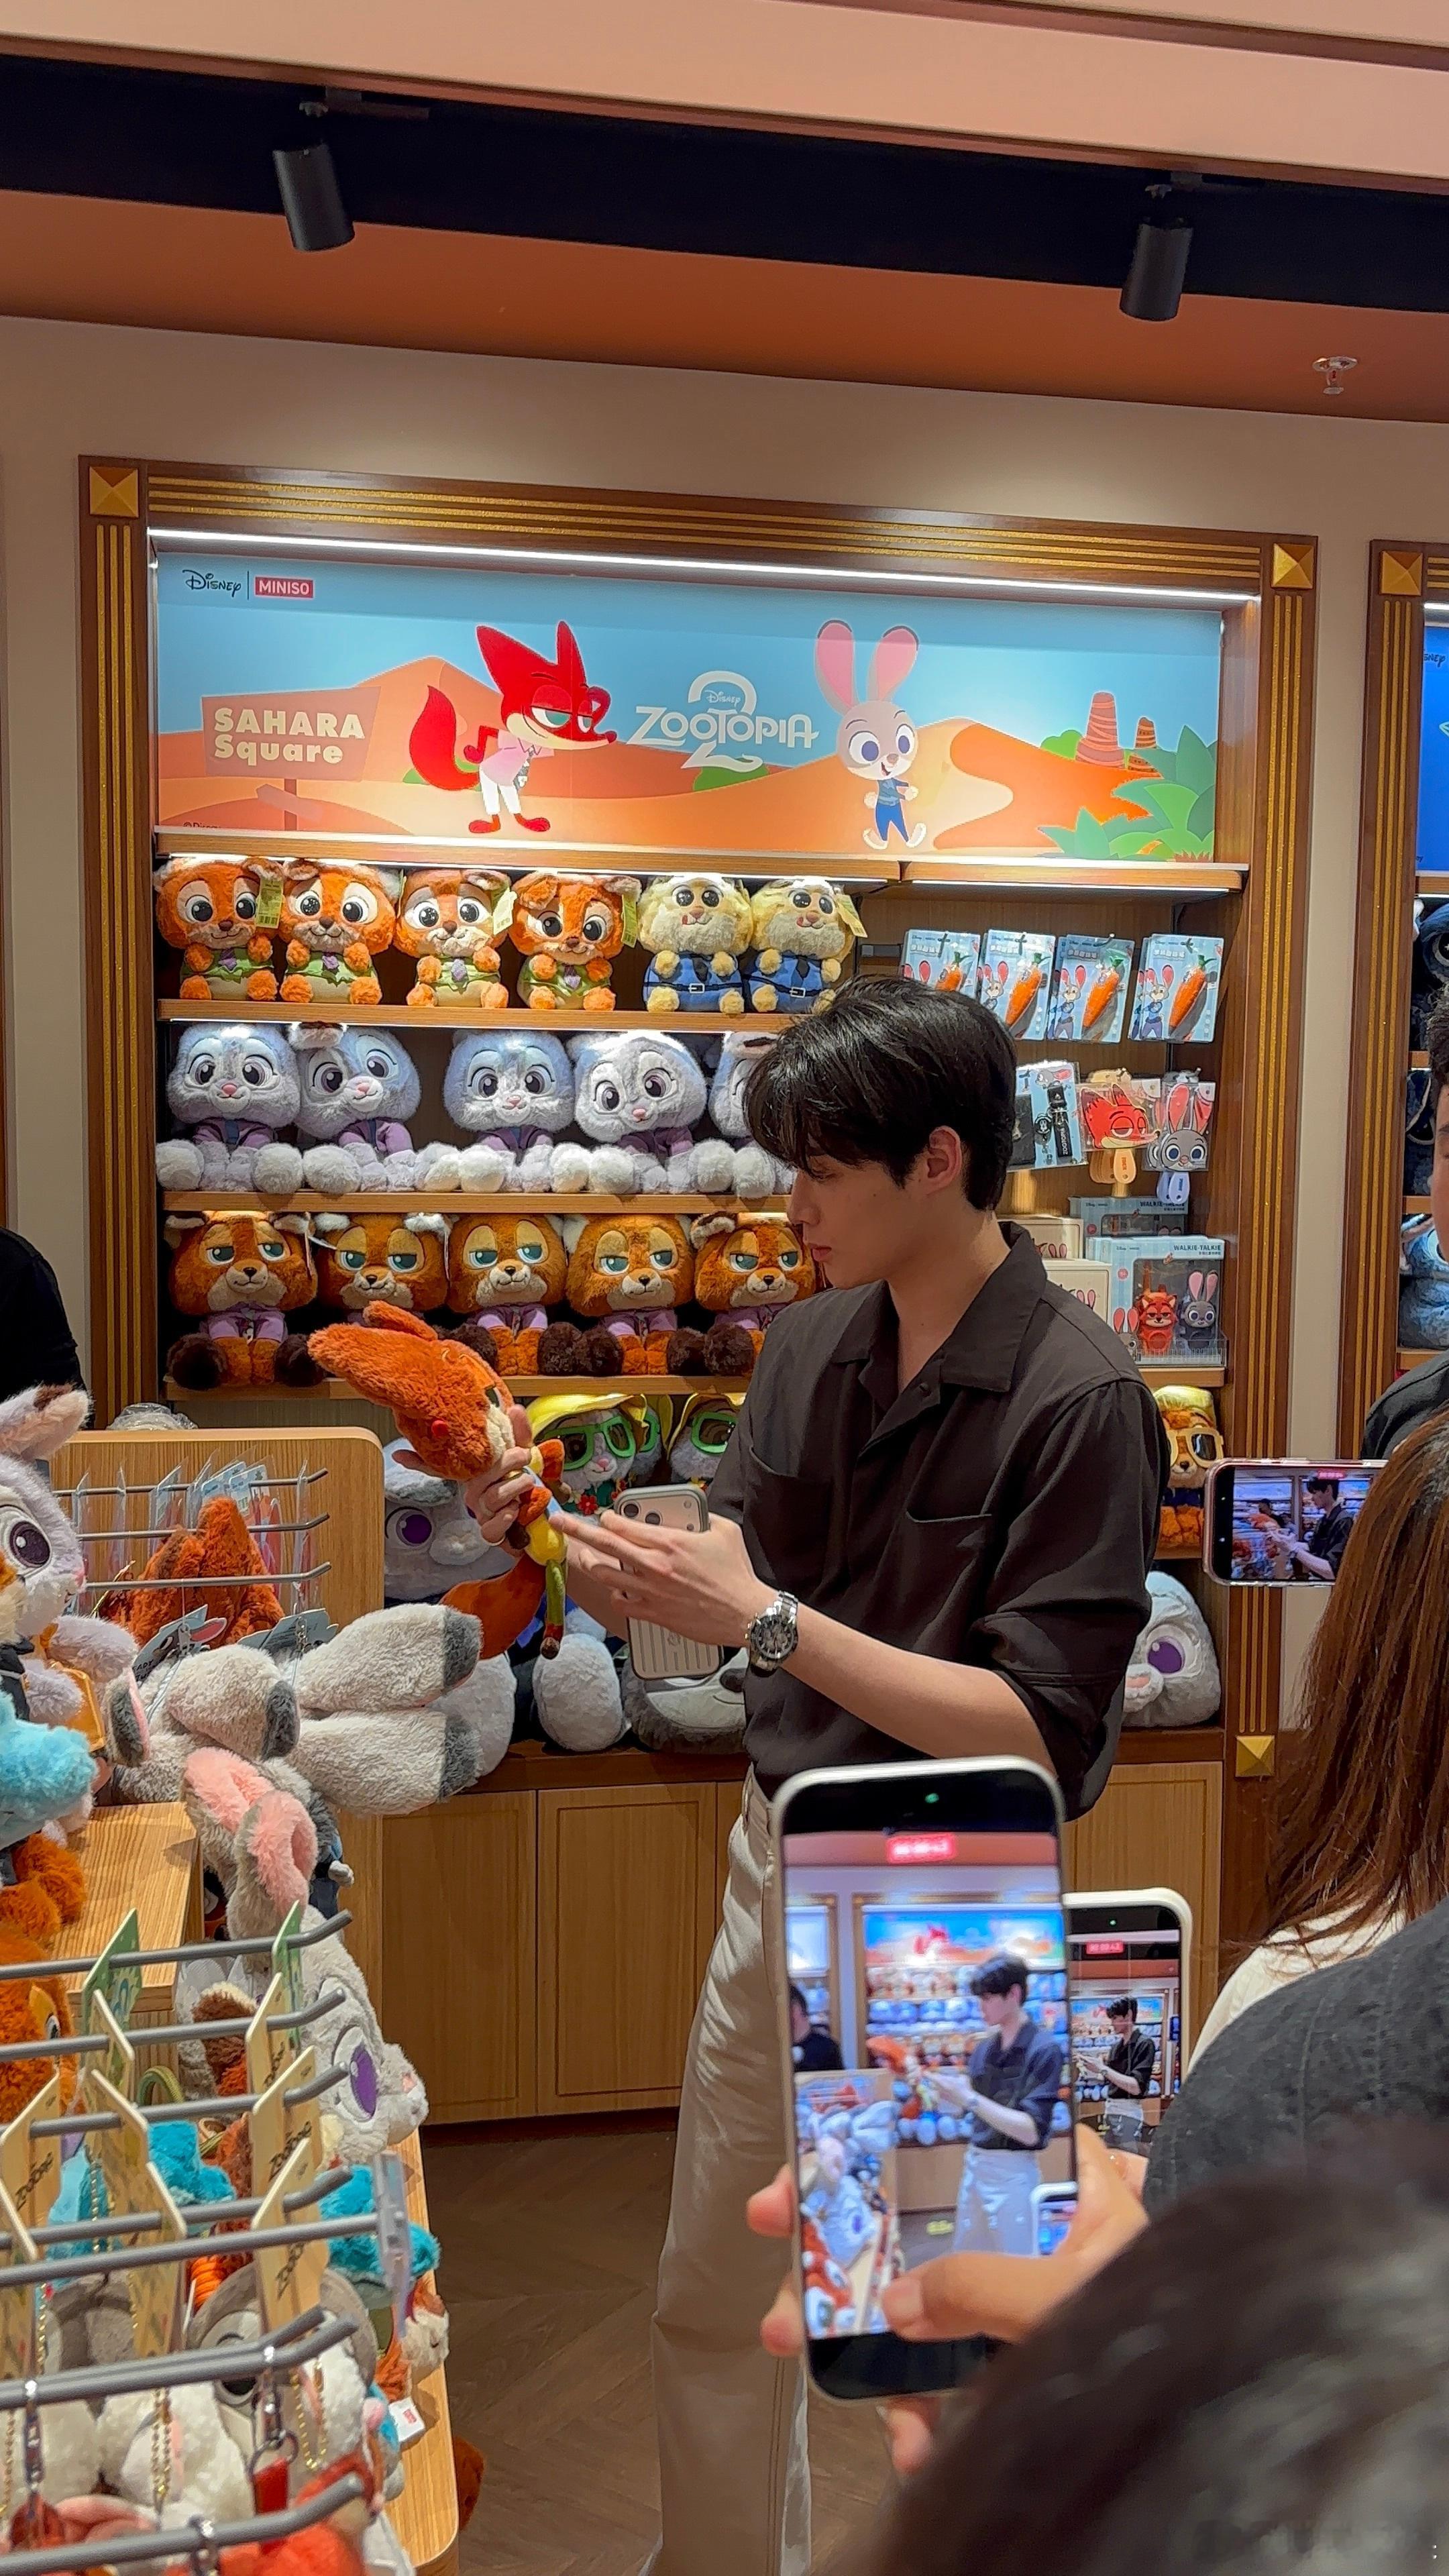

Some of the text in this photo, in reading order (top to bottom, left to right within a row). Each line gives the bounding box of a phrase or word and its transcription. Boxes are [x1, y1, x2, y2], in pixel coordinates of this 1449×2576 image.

[181, 570, 309, 597] Disney MINISO
[214, 707, 366, 739] SAHARA
[214, 734, 343, 766] Square
